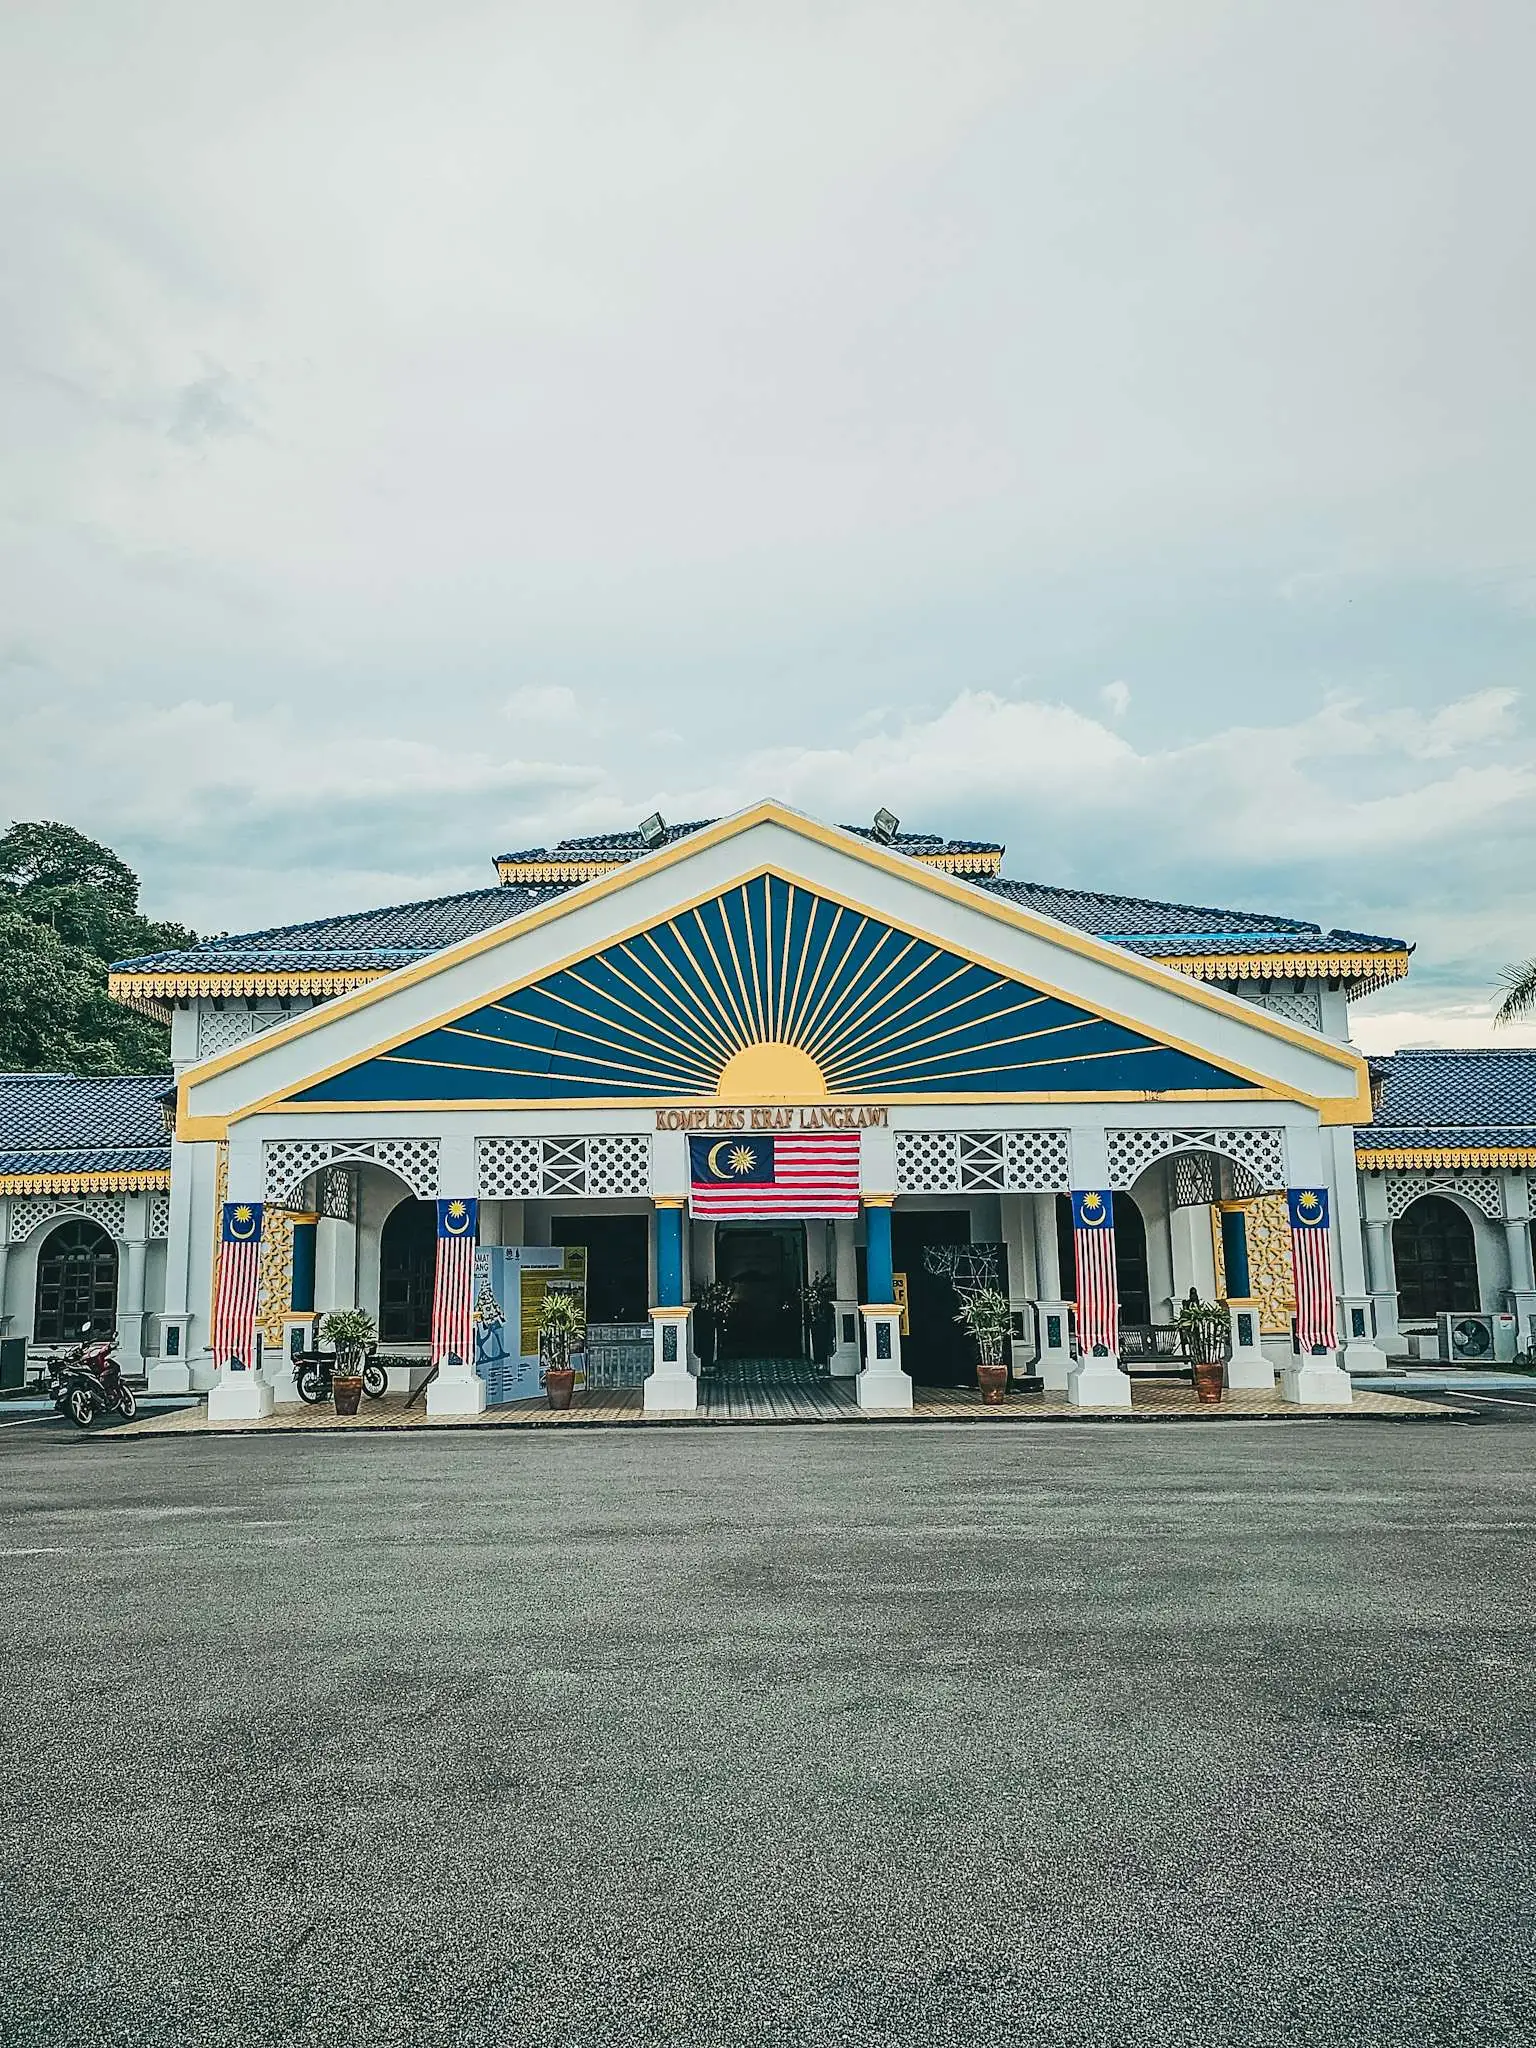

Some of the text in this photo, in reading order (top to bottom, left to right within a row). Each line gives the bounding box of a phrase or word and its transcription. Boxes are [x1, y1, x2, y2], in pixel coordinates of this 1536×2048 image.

[656, 1107, 889, 1130] KOMPLEKS KRAF LANGKAWI
